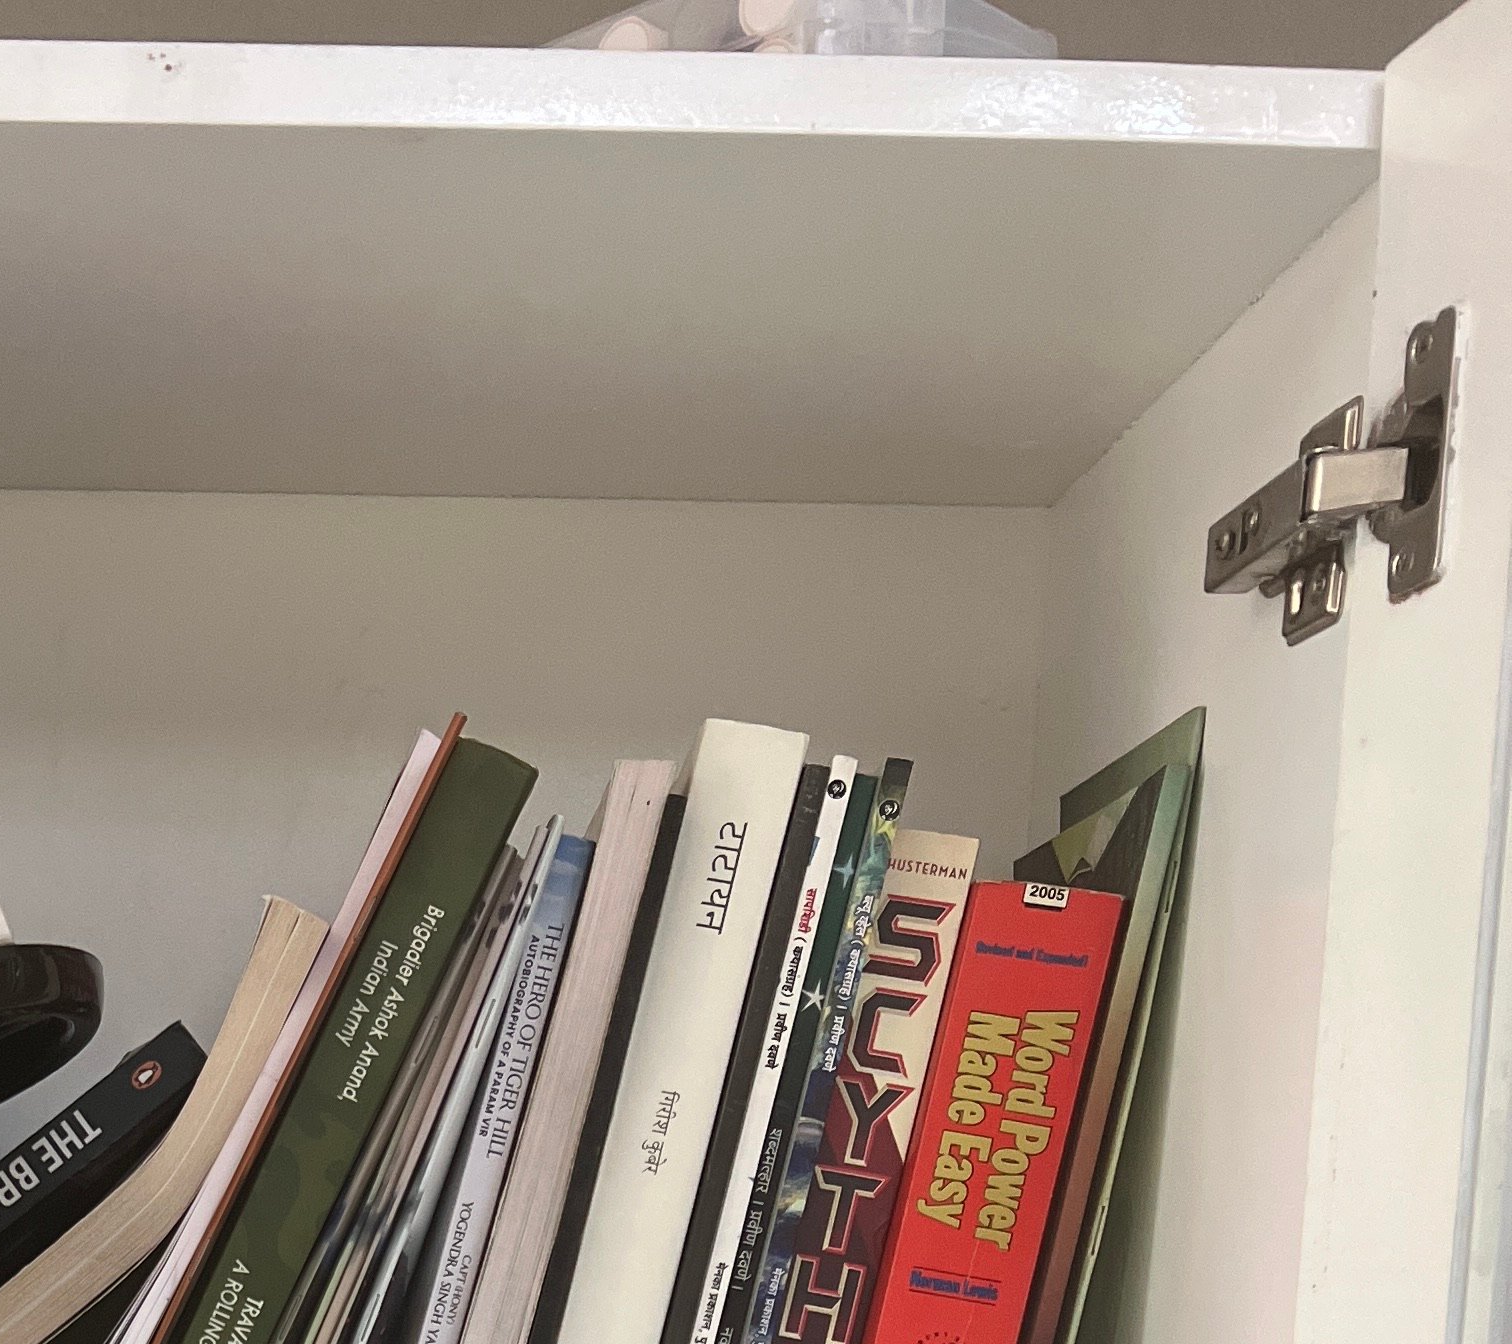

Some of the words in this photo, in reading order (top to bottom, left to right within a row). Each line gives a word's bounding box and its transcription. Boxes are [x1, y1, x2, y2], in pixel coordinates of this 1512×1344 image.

[694, 816, 747, 935] टाटायन
[887, 858, 968, 881] HUSTERMAN
[1029, 884, 1065, 902] 2005
[358, 938, 398, 998] Indian
[390, 901, 445, 988] Brigadier
[538, 920, 565, 963] THE
[332, 995, 372, 1048] Army
[368, 985, 407, 1042] Ashok
[522, 964, 553, 1022] HERO
[514, 1022, 538, 1053] OF
[1000, 998, 1081, 1121] Word
[336, 1039, 382, 1107] Anand,
[497, 1049, 531, 1114] TIGER
[941, 1005, 1022, 1133] Made
[28, 1104, 105, 1174] THE
[484, 1117, 512, 1162] HILL
[649, 1088, 680, 1136] गिरीश
[635, 1137, 671, 1178] कुबेर
[912, 1123, 993, 1231] Easy
[967, 1113, 1052, 1254] Power
[230, 1257, 252, 1276] A
[441, 1199, 474, 1280] YOGENDRA
[430, 1280, 452, 1325] SINGH
